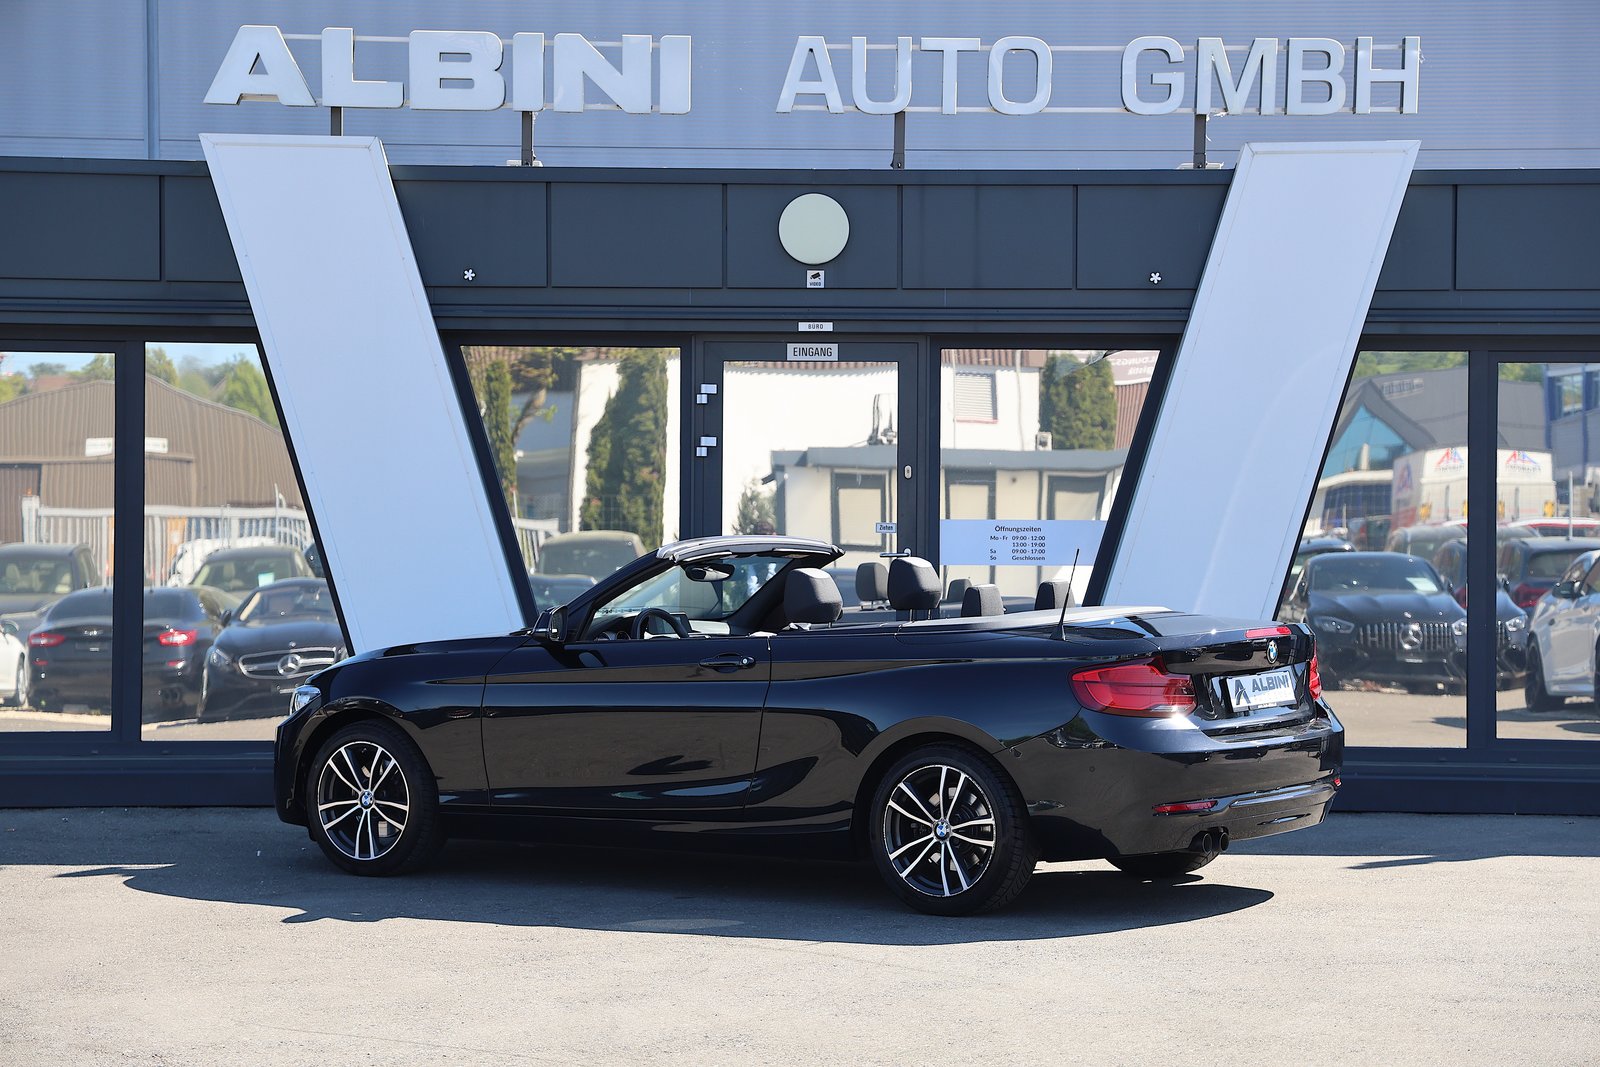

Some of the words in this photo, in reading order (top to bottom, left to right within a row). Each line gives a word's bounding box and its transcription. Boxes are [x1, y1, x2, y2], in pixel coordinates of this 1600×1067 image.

[203, 24, 692, 115] ALBINI
[776, 35, 1053, 115] AUTO
[1121, 35, 1421, 116] GMBH
[793, 347, 833, 357] EINGANG
[994, 525, 1042, 533] Öffnungszeiten
[1252, 674, 1290, 693] ALBINI
